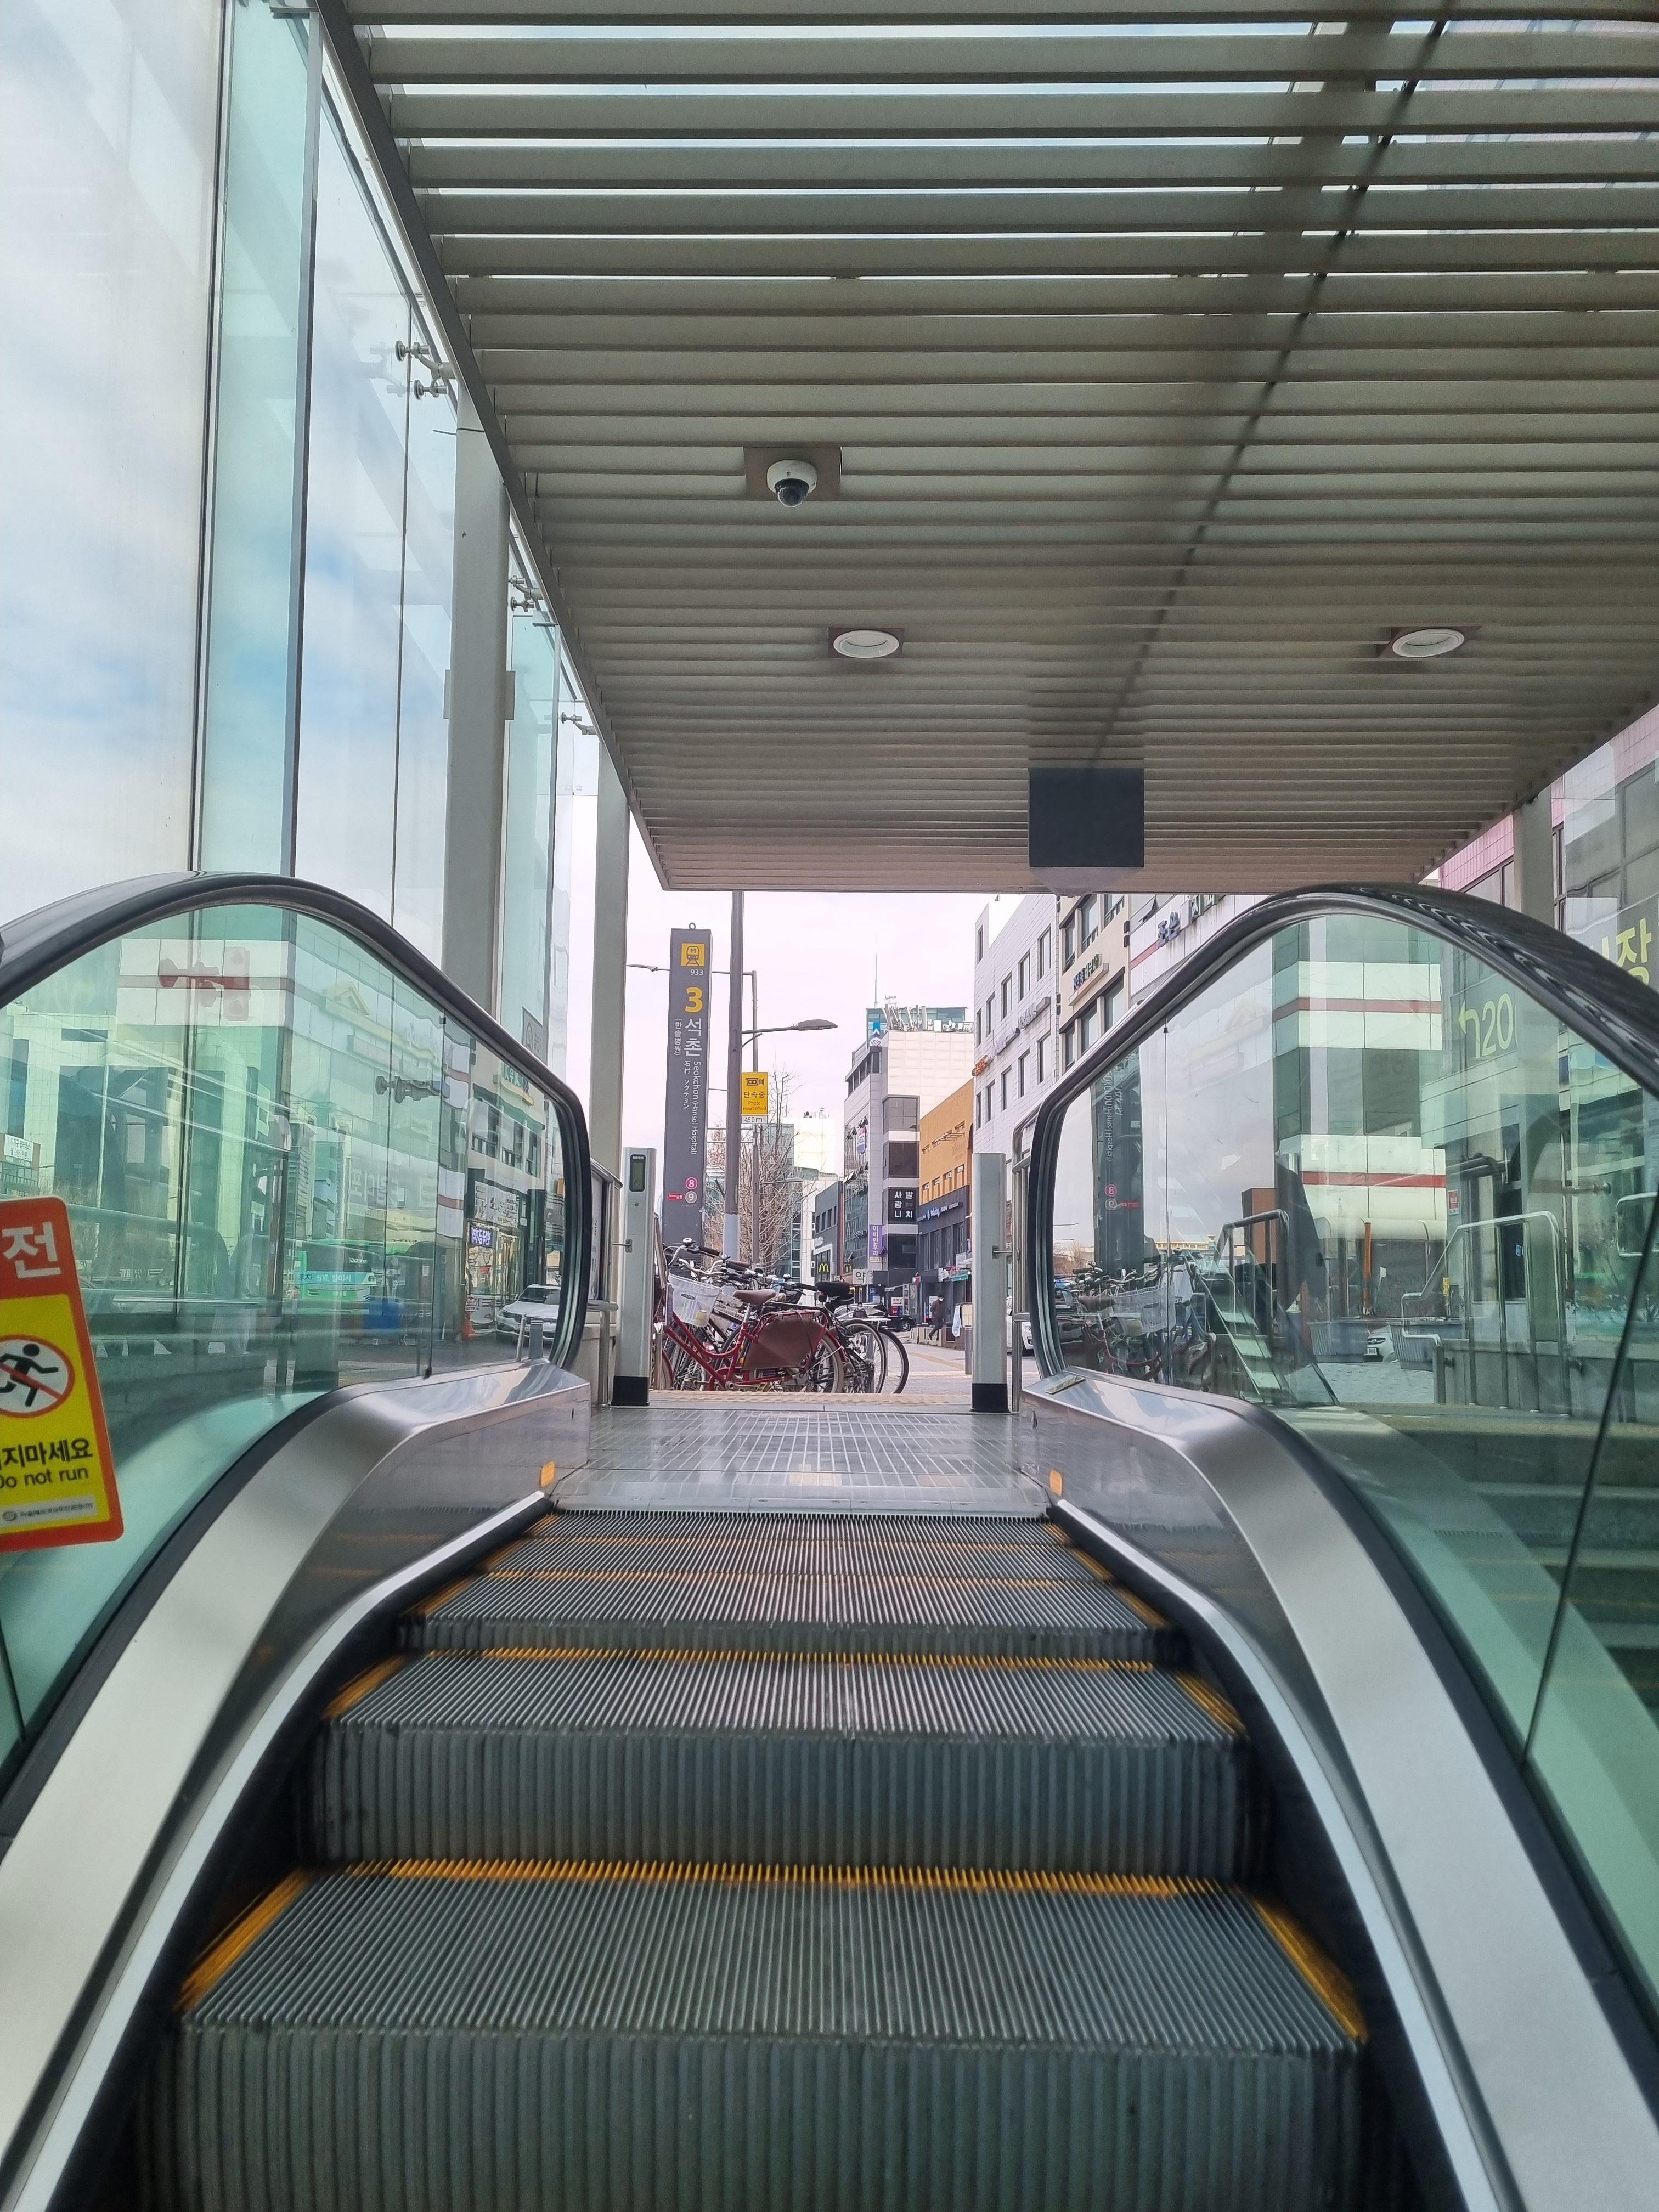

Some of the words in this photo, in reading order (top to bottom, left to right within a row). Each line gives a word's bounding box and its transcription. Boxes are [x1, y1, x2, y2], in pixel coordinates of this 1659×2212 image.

[685, 987, 703, 1012] 3
[674, 1018, 682, 1056] (한솔병원)
[684, 1018, 702, 1056] 석촌
[684, 1060, 691, 1074] 石村
[692, 1061, 701, 1100] Seokchon
[690, 1126, 698, 1155] Hospital)
[689, 1179, 695, 1187] 8
[2, 1221, 61, 1279] 전
[0, 1438, 93, 1470] 지마세요
[24, 1469, 52, 1487] not
[58, 1467, 89, 1482] run
